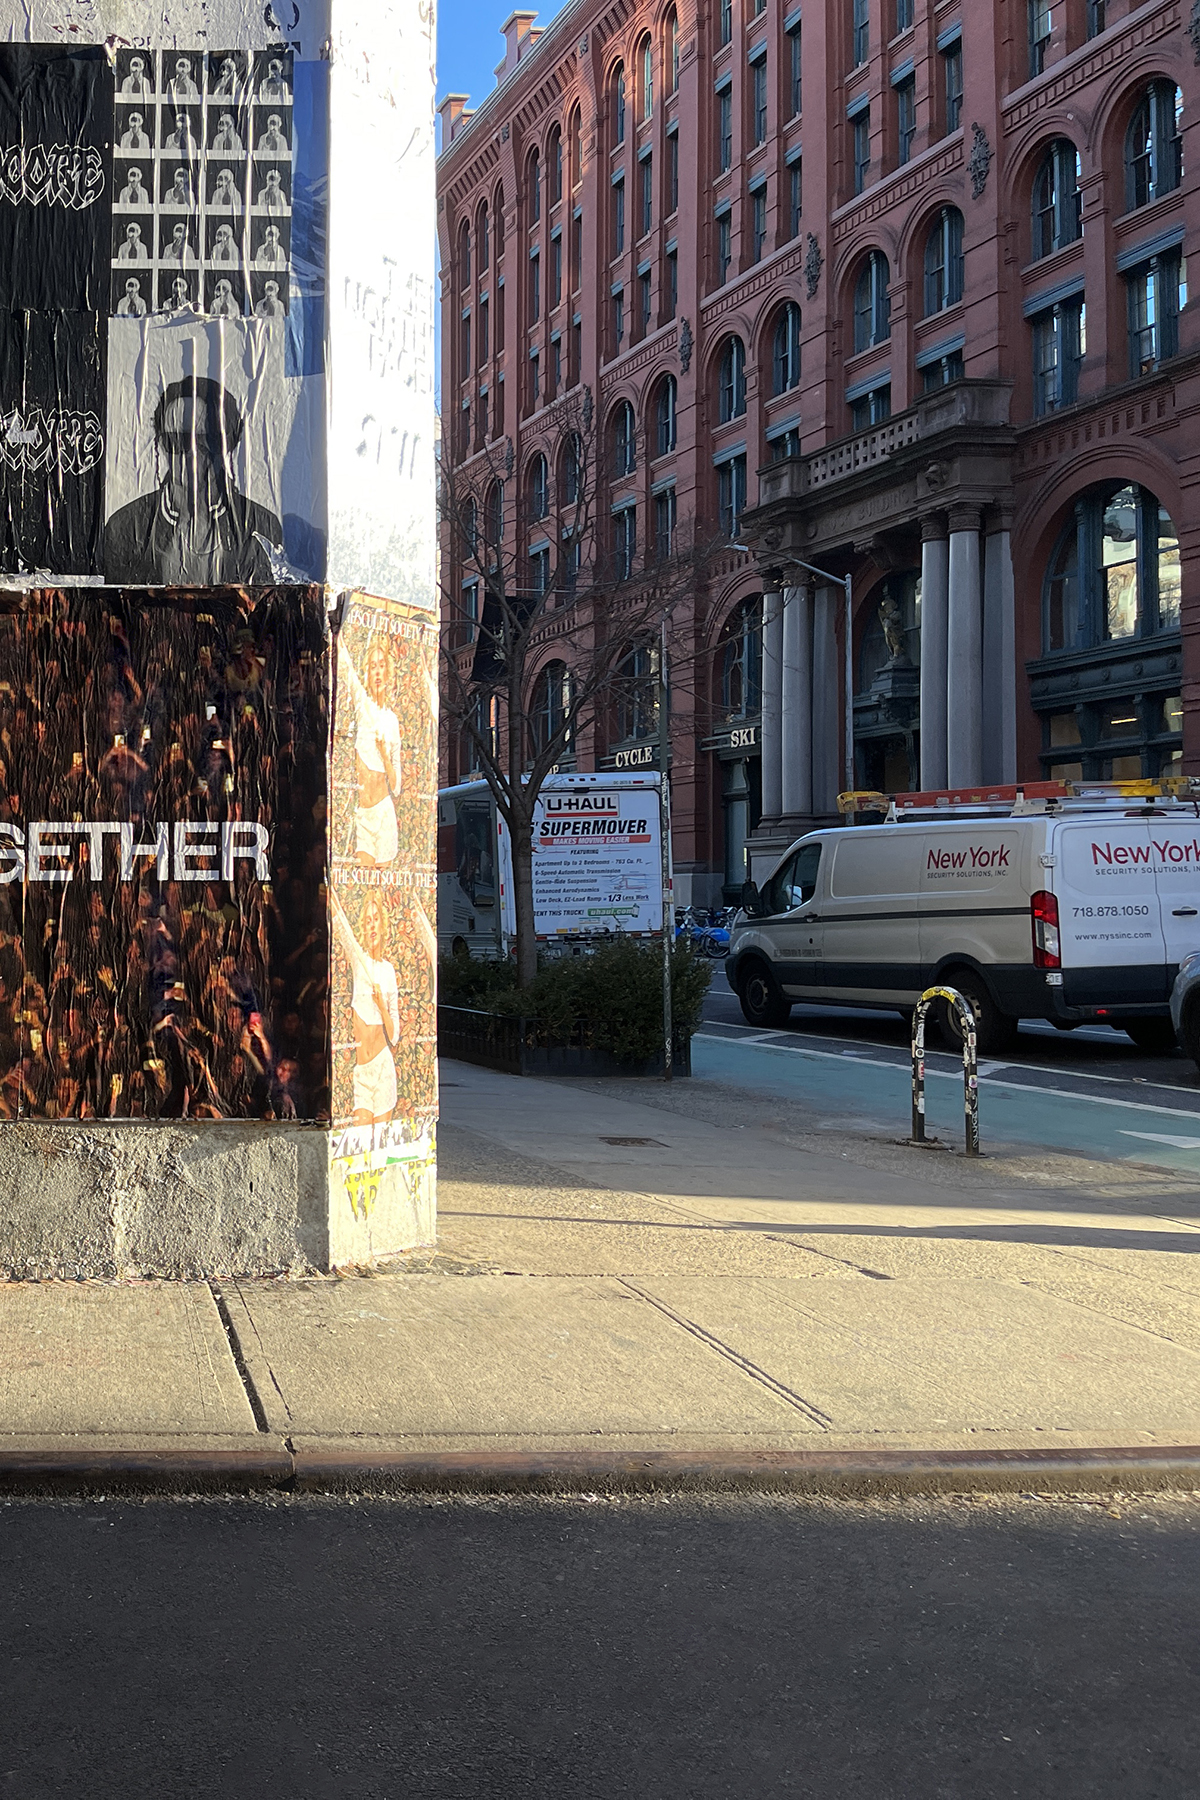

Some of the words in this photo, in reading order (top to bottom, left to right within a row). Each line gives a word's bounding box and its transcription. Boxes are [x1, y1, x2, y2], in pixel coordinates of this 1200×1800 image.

[356, 612, 390, 632] SCULPT
[390, 619, 421, 640] SOCIETY
[730, 727, 756, 748] SKI
[615, 747, 652, 768] CYCLE
[547, 797, 616, 810] U-HAUL
[540, 820, 647, 836] SUPERMOVER
[605, 836, 630, 844] EASIER
[927, 871, 955, 879] SECURITY
[956, 870, 993, 878] SOLUTIONS,
[1095, 867, 1138, 875] SECURITY
[1141, 866, 1191, 874] SOLUTIONS,
[333, 868, 350, 884] THE
[351, 868, 381, 885] SCULPT
[382, 869, 413, 886] SOCIETY
[415, 872, 431, 887] THE
[608, 894, 621, 902] 1/3
[1072, 905, 1149, 917] 718.878.1050
[1075, 932, 1152, 941] www.nyssinc.com
